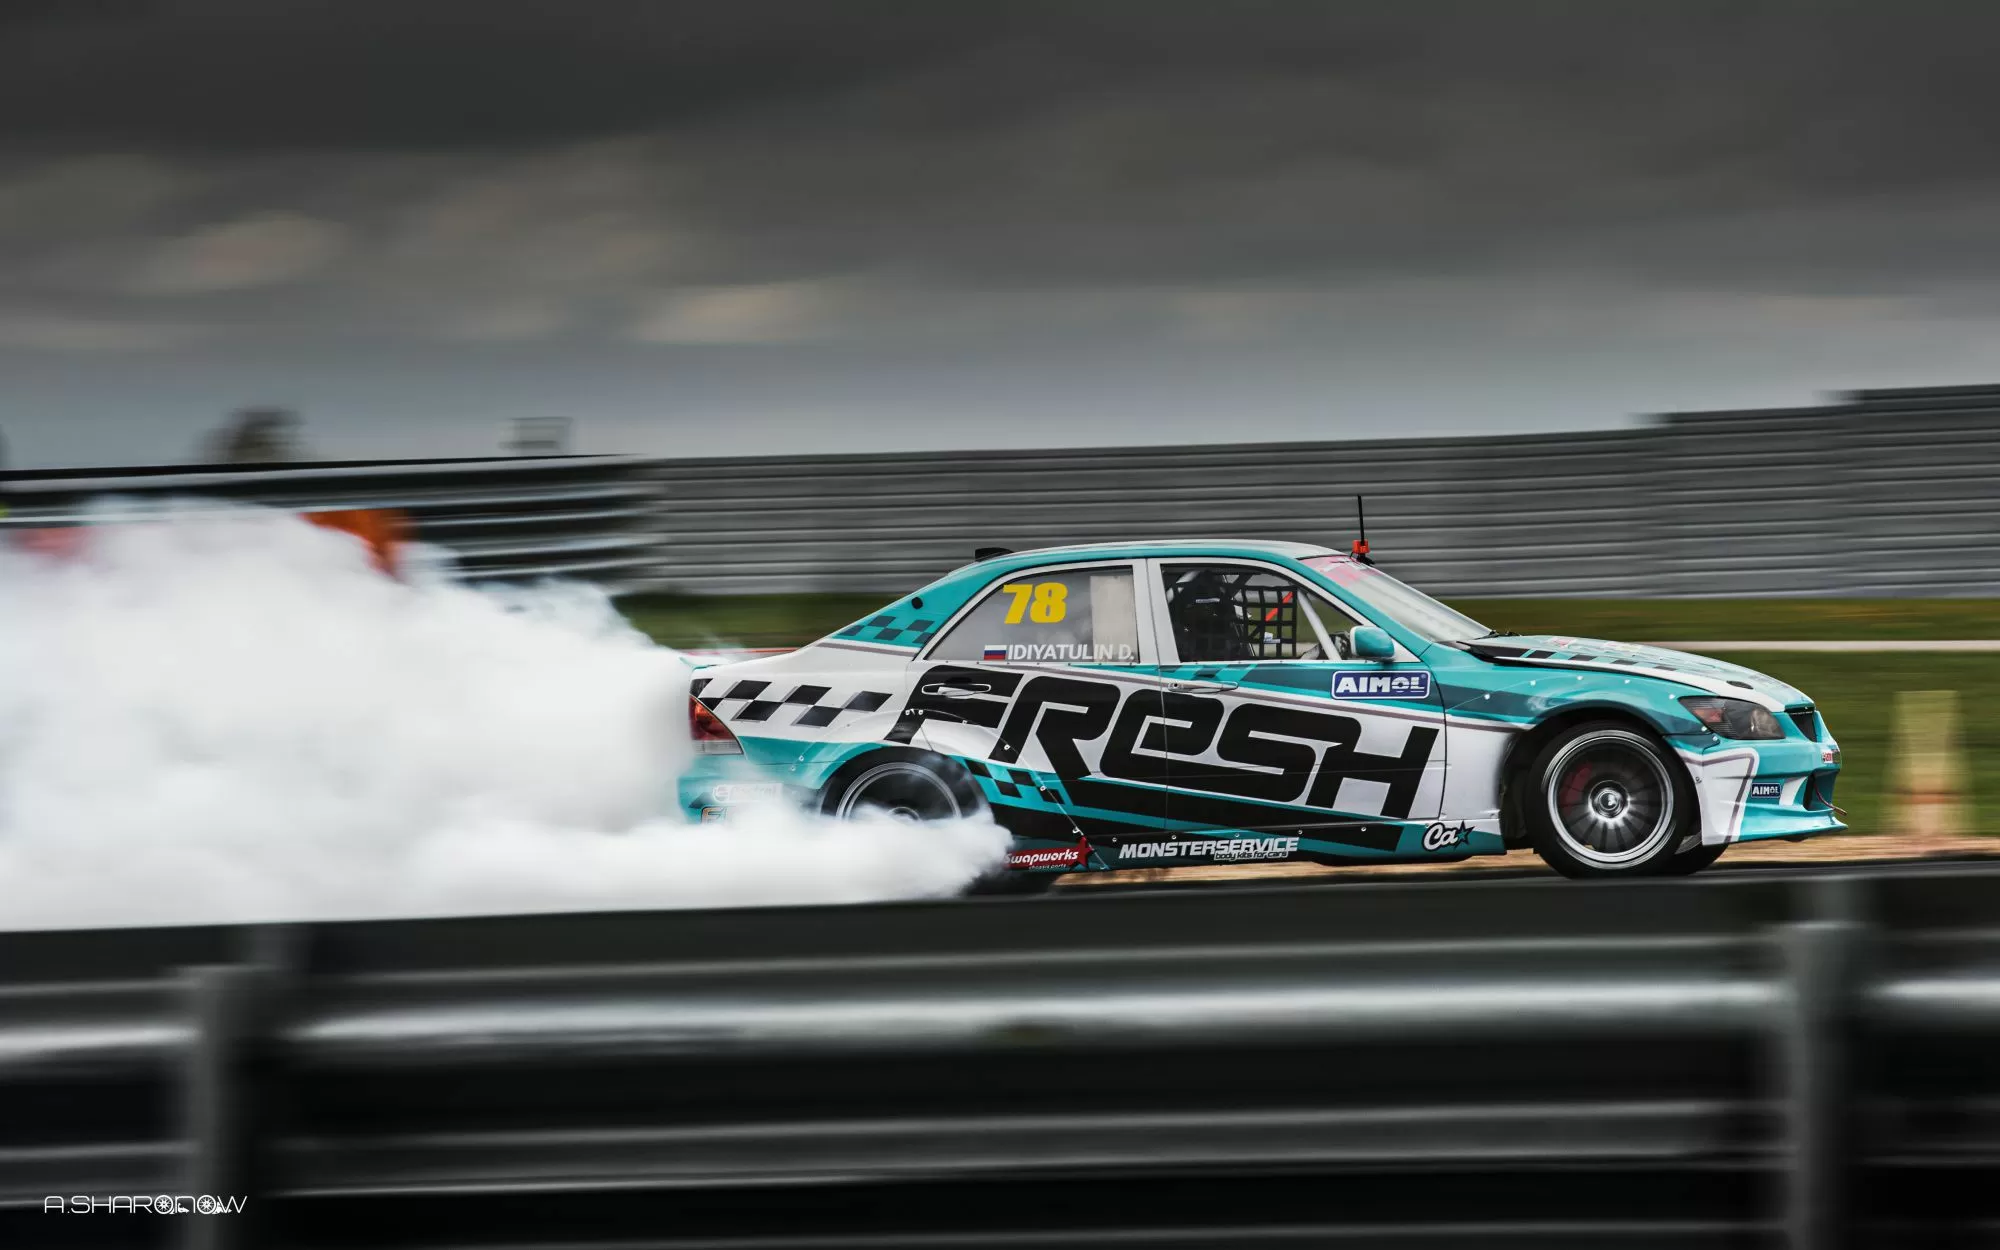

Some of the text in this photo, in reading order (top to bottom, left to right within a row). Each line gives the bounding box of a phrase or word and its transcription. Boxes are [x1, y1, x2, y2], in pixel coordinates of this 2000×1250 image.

[1003, 582, 1068, 624] 78
[1008, 644, 1135, 660] IDIYATULIN D.
[1336, 676, 1425, 693] AIMOL
[1119, 837, 1299, 859] MONSTERSERVICE
[1215, 851, 1236, 860] body
